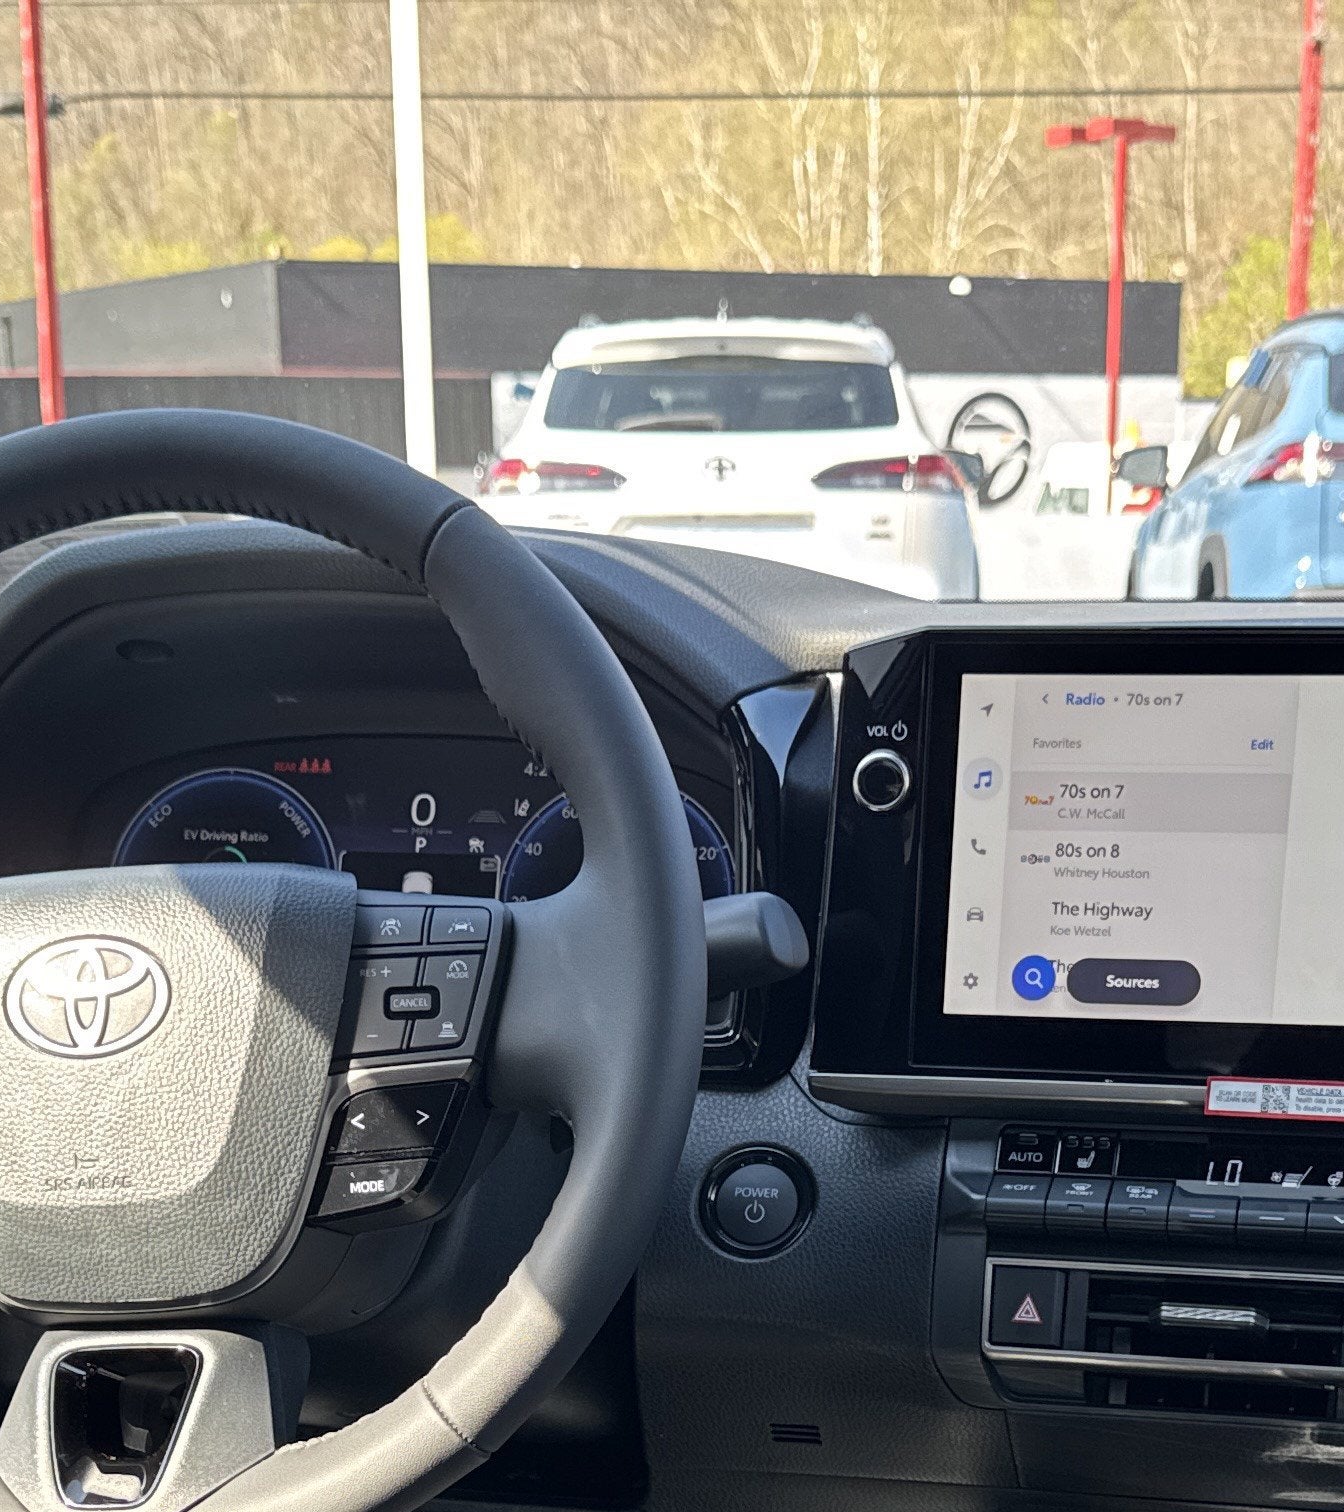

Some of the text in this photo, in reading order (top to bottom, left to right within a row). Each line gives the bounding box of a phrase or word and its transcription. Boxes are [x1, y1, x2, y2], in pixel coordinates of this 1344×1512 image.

[1065, 693, 1184, 706] Radio 70s on 7
[867, 725, 889, 737] VOL
[1033, 737, 1082, 750] Favorites
[1250, 739, 1274, 751] Edit
[1060, 784, 1125, 799] 70s on 7
[147, 803, 173, 829] ECO
[411, 793, 436, 826] 0
[1086, 808, 1126, 820] McCall
[279, 801, 311, 839] POWER
[183, 830, 269, 844] EV Driving Ratio
[415, 837, 427, 853] P
[524, 843, 542, 857] 40
[1055, 843, 1120, 858] 80s on 8
[1054, 867, 1150, 881] Whitney Houston
[1052, 902, 1153, 921] The Highway
[1050, 925, 1112, 937] Koe Wetzel
[360, 968, 377, 978] RES
[446, 971, 469, 979] MODE
[1105, 974, 1160, 989] Sources
[393, 998, 428, 1008] CANCEL
[1008, 1152, 1043, 1163] AUTO
[1206, 1159, 1243, 1186] LO
[349, 1180, 385, 1194] MODE
[734, 1187, 779, 1199] POWER
[1065, 1189, 1093, 1197] FRONT
